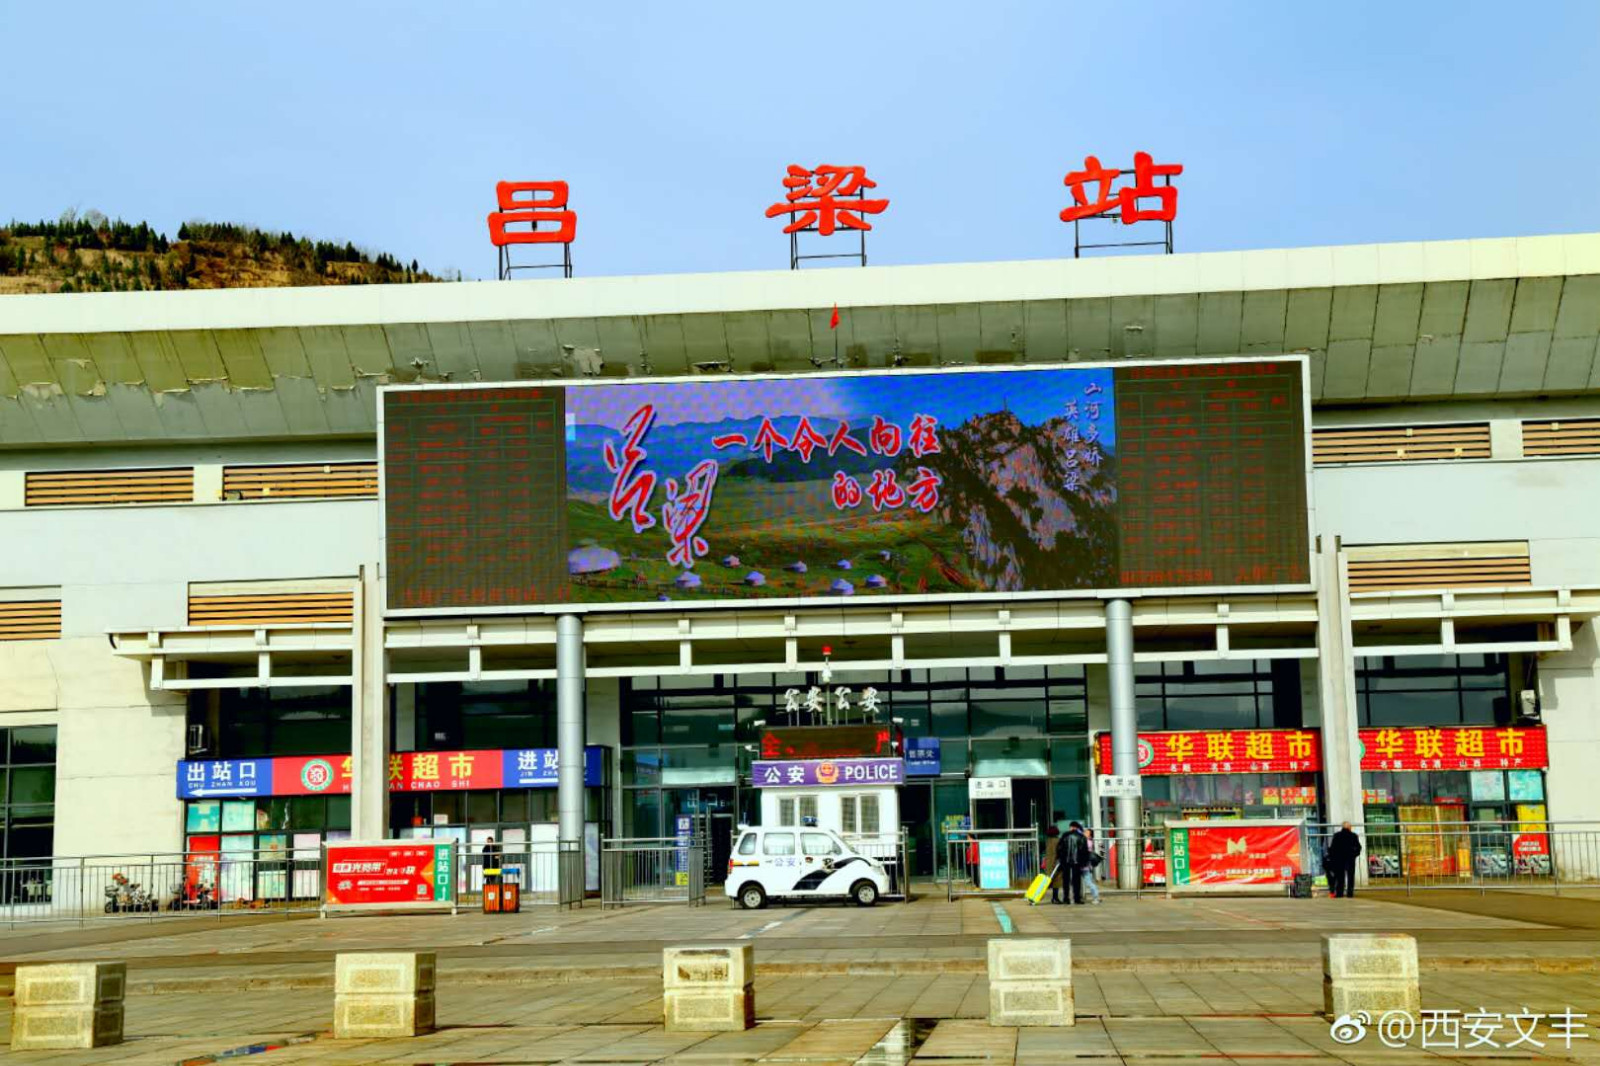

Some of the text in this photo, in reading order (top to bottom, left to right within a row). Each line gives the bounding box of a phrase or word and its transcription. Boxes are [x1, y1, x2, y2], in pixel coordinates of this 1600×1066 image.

[488, 151, 1183, 245] 吕梁站
[712, 414, 941, 462] 一个令人向往
[832, 467, 942, 513] 的地方
[1165, 731, 1313, 762] 华联超市
[1375, 728, 1525, 758] 华联超市
[187, 762, 256, 782] 出站口
[764, 766, 806, 783] 公安
[845, 764, 898, 780] POLICE
[410, 781, 440, 789] CHAO
[774, 857, 796, 867] 公安
